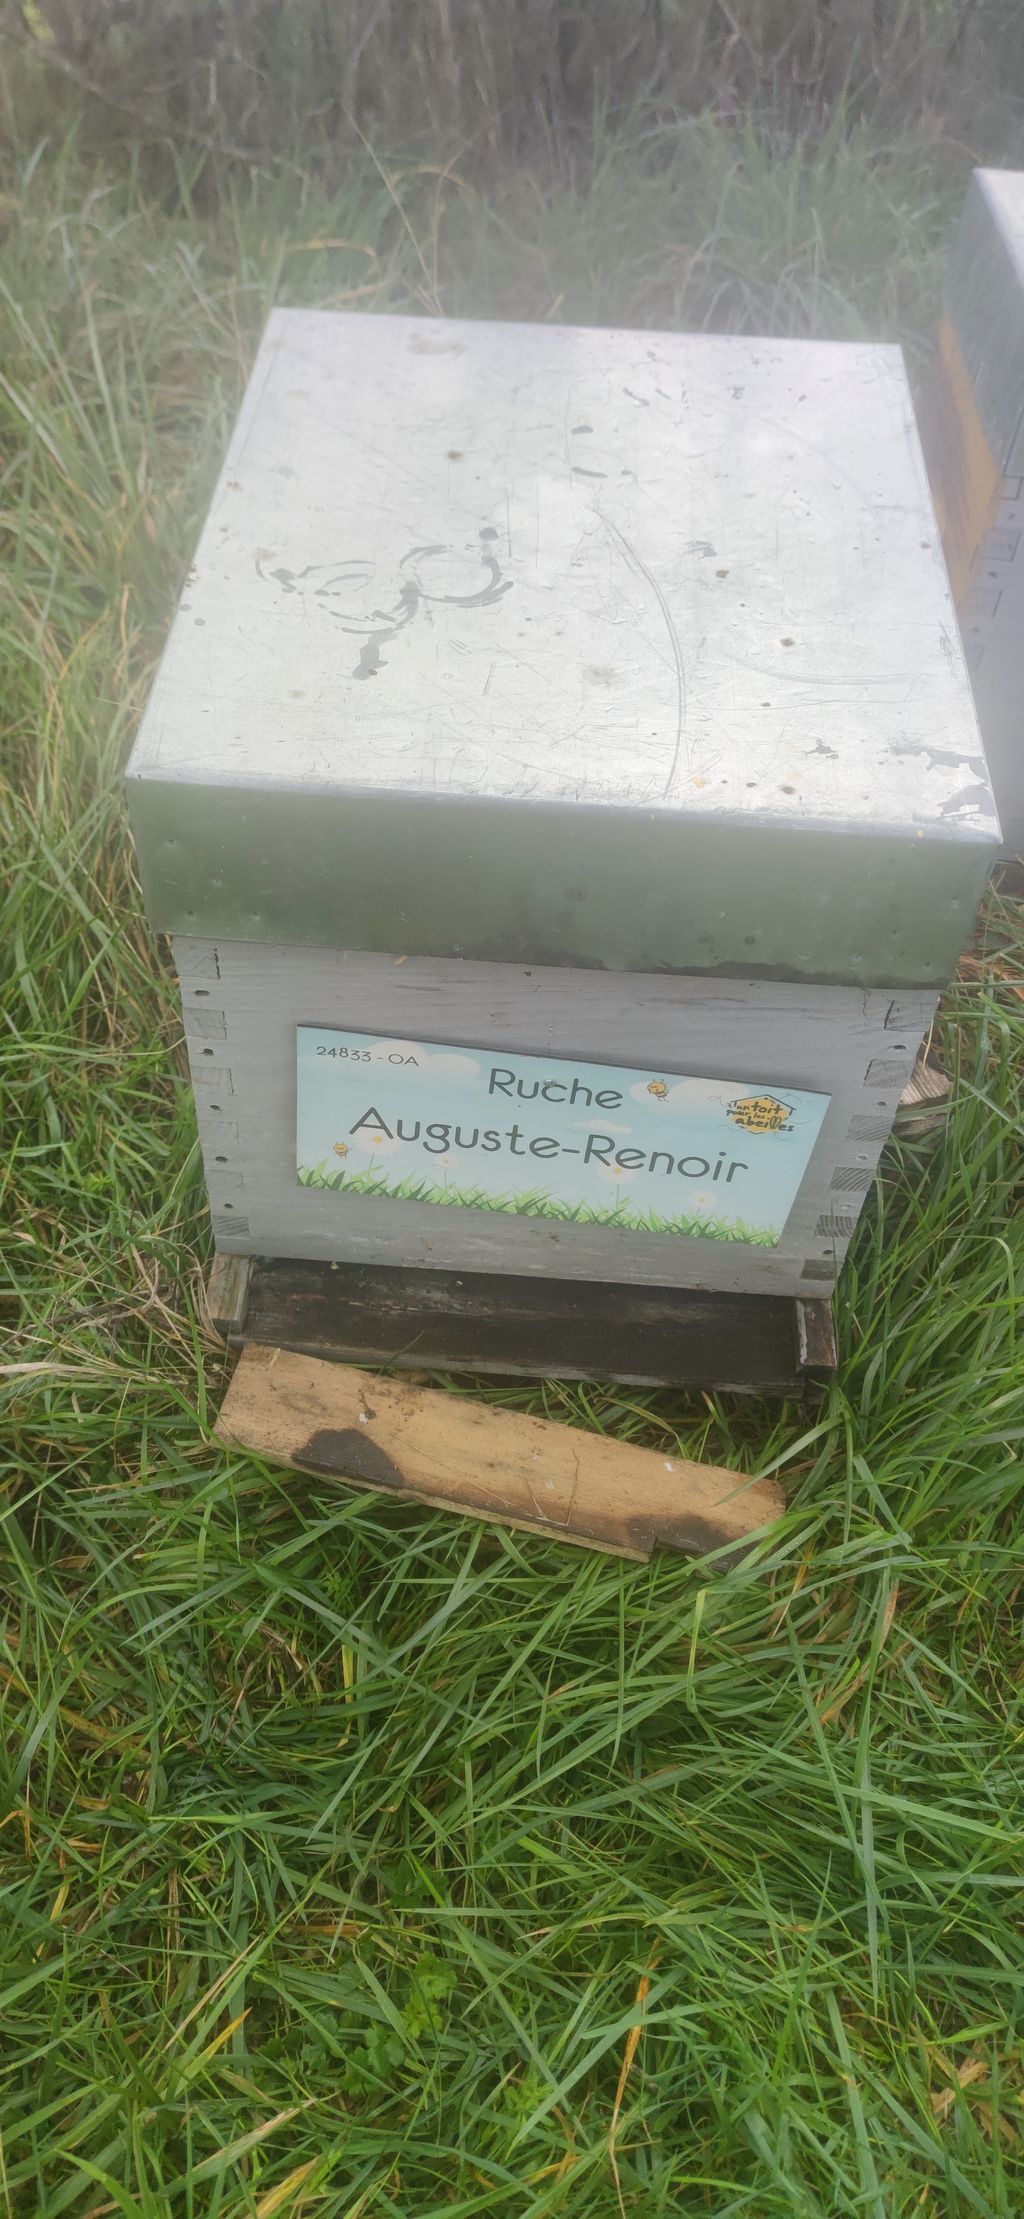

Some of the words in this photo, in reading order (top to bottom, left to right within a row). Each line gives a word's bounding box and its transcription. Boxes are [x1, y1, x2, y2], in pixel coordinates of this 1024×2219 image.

[316, 1046, 371, 1062] 24833
[488, 1067, 623, 1110] Ruche
[751, 1101, 783, 1115] toit
[735, 1115, 795, 1132] abeilles
[349, 1106, 749, 1183] Auguste-Renoir
